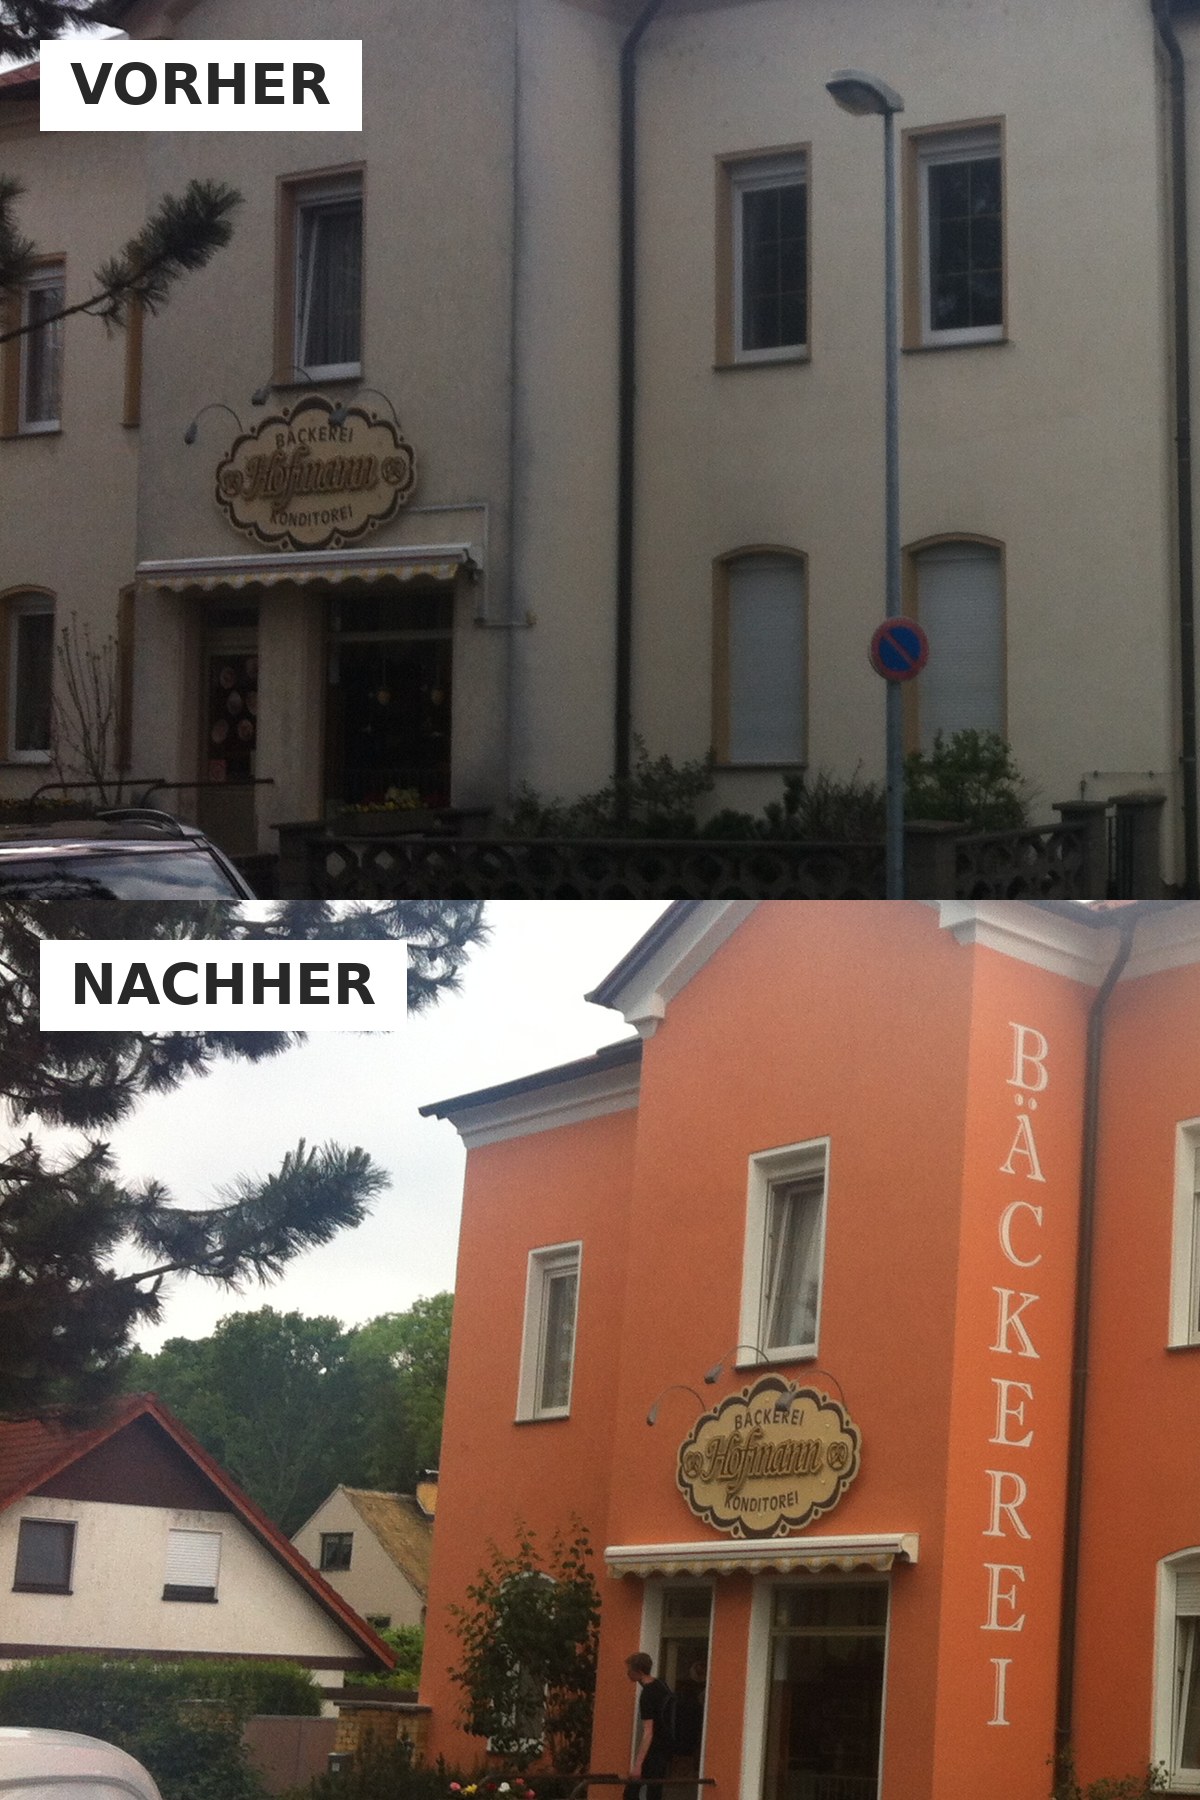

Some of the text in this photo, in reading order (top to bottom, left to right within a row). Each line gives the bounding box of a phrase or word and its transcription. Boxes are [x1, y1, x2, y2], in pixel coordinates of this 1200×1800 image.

[242, 446, 379, 510] Hofmann
[270, 505, 353, 527] KONDITOREI
[980, 1021, 1049, 1726] BÄCKEREI
[701, 1428, 823, 1493] Hofmann
[724, 1490, 799, 1512] KONDITOREI
